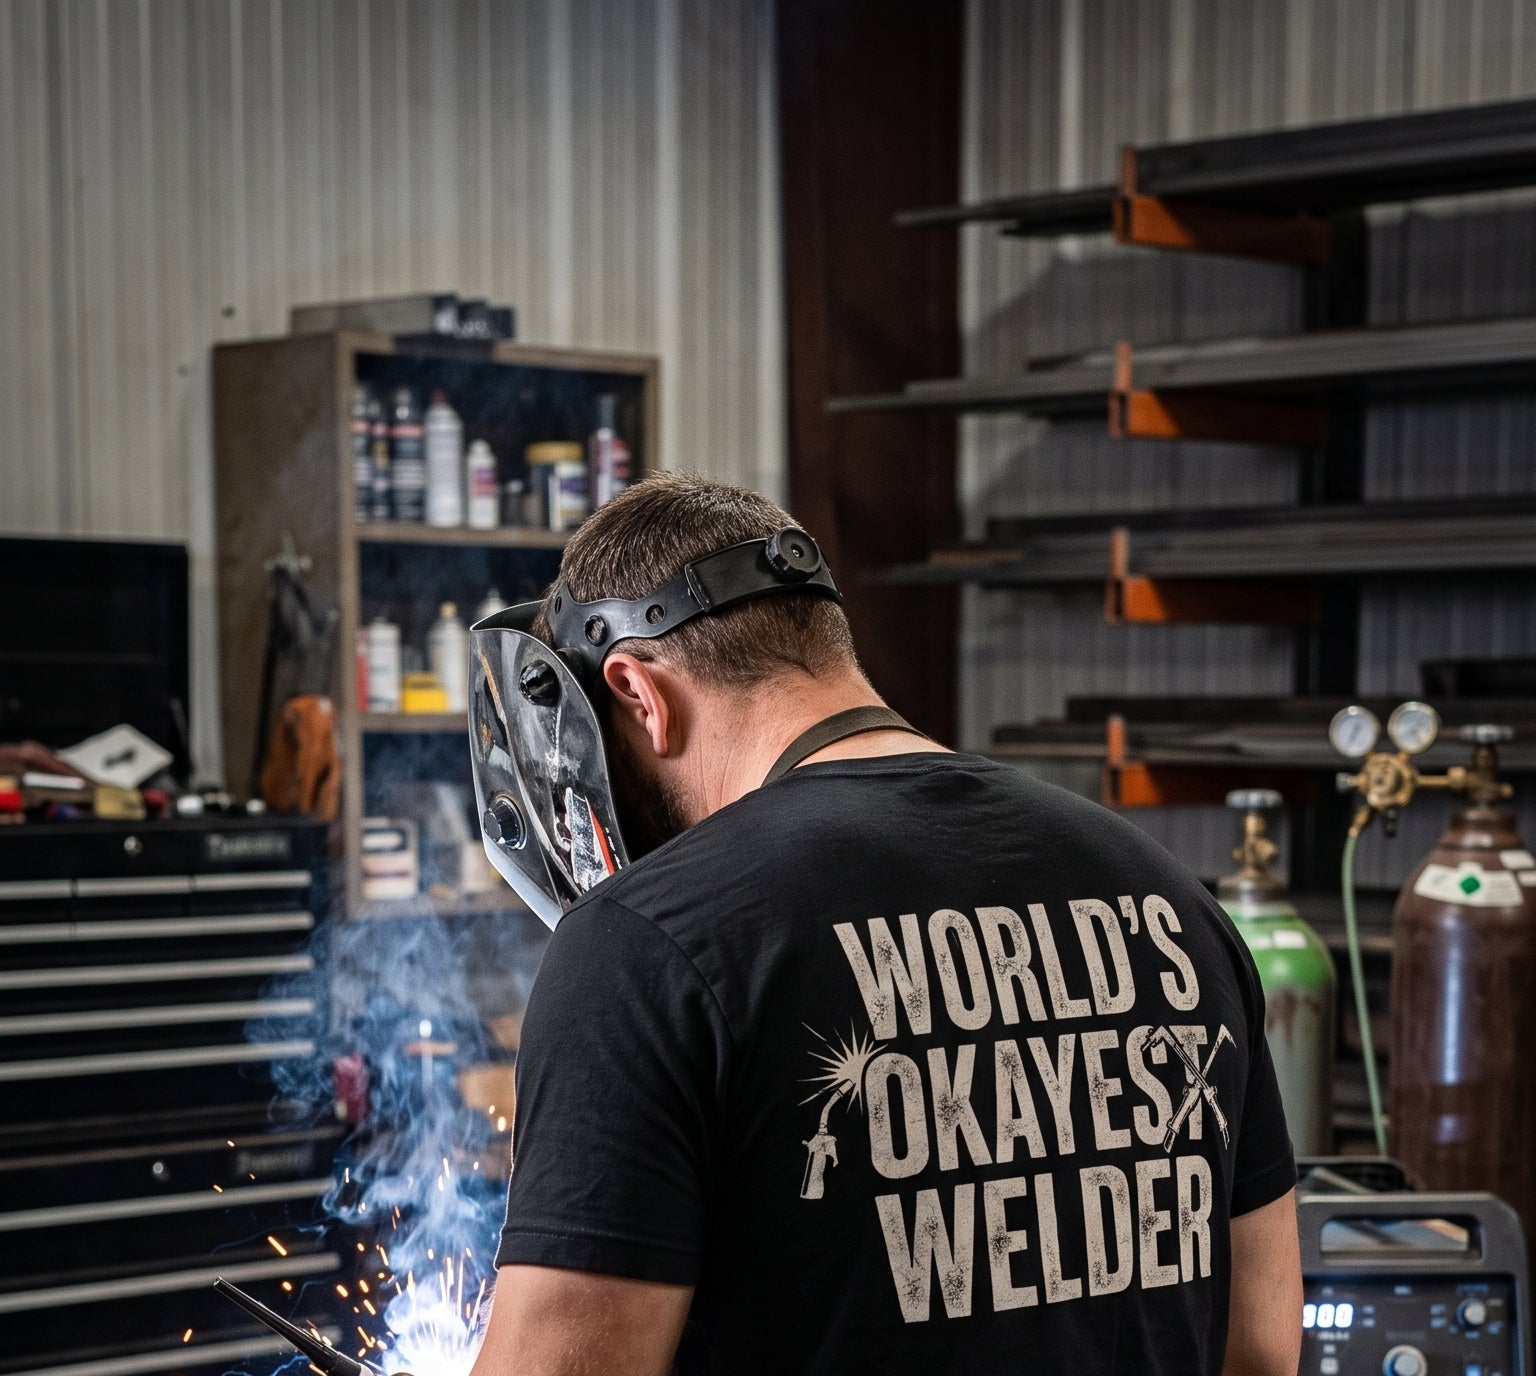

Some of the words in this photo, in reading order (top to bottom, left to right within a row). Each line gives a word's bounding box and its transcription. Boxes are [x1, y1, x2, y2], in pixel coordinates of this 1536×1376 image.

[833, 894, 1200, 1041] WORLD'S
[865, 1025, 1208, 1179] OKAYEST
[875, 1155, 1212, 1323] WELDER
